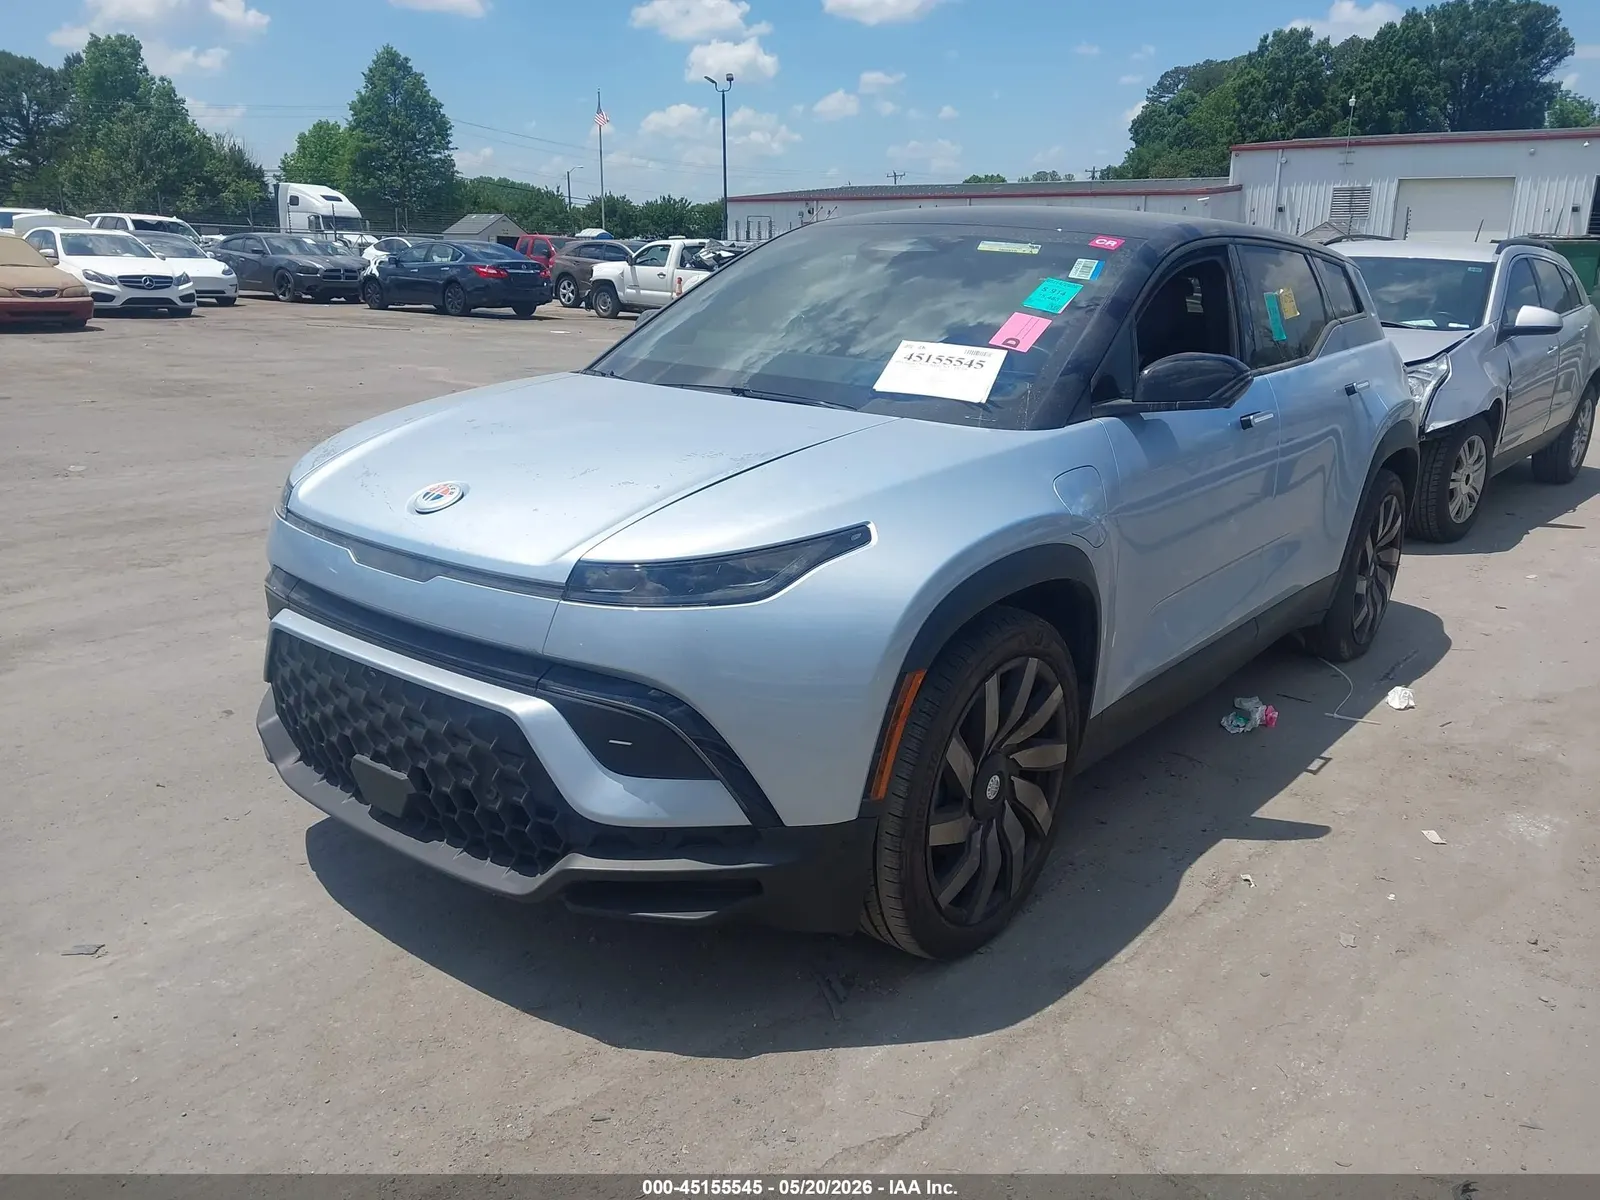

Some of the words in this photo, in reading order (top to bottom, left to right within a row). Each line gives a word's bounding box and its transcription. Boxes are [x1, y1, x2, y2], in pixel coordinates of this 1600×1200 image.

[1095, 238, 1118, 247] CR
[1001, 337, 1021, 348] D
[903, 352, 987, 370] 45155545
